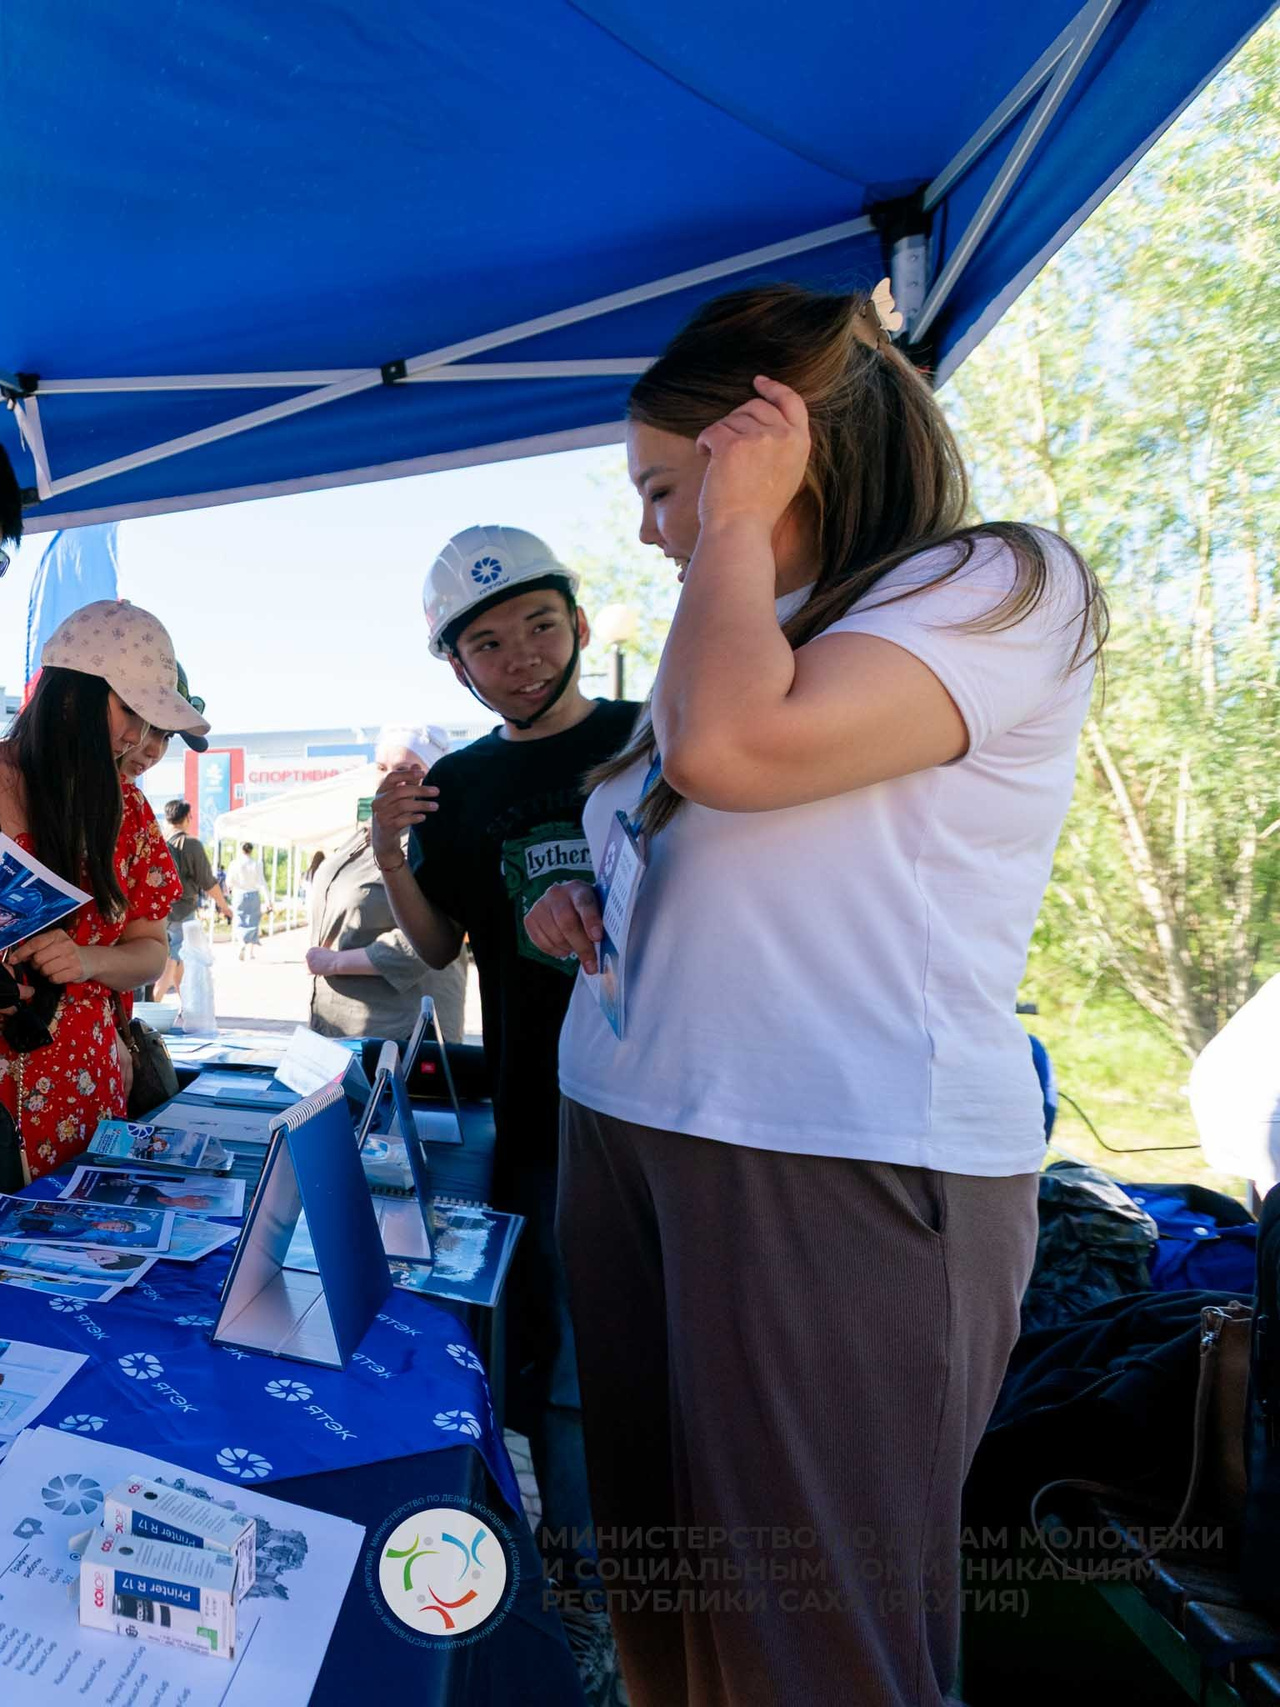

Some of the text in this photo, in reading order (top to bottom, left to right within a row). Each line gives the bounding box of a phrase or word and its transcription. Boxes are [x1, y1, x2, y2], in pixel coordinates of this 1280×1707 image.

[527, 844, 592, 876] lyther
[137, 1280, 165, 1301] ТЭК
[74, 1314, 111, 1340] ЯТЭК
[375, 1313, 423, 1337] ЯТЭК
[152, 1382, 200, 1413] ЯТЭК
[303, 1404, 358, 1441] ЯТЭК
[138, 1519, 196, 1548] Printer R 17
[94, 1571, 105, 1608] COLOP
[122, 1578, 191, 1602] Printer R 17
